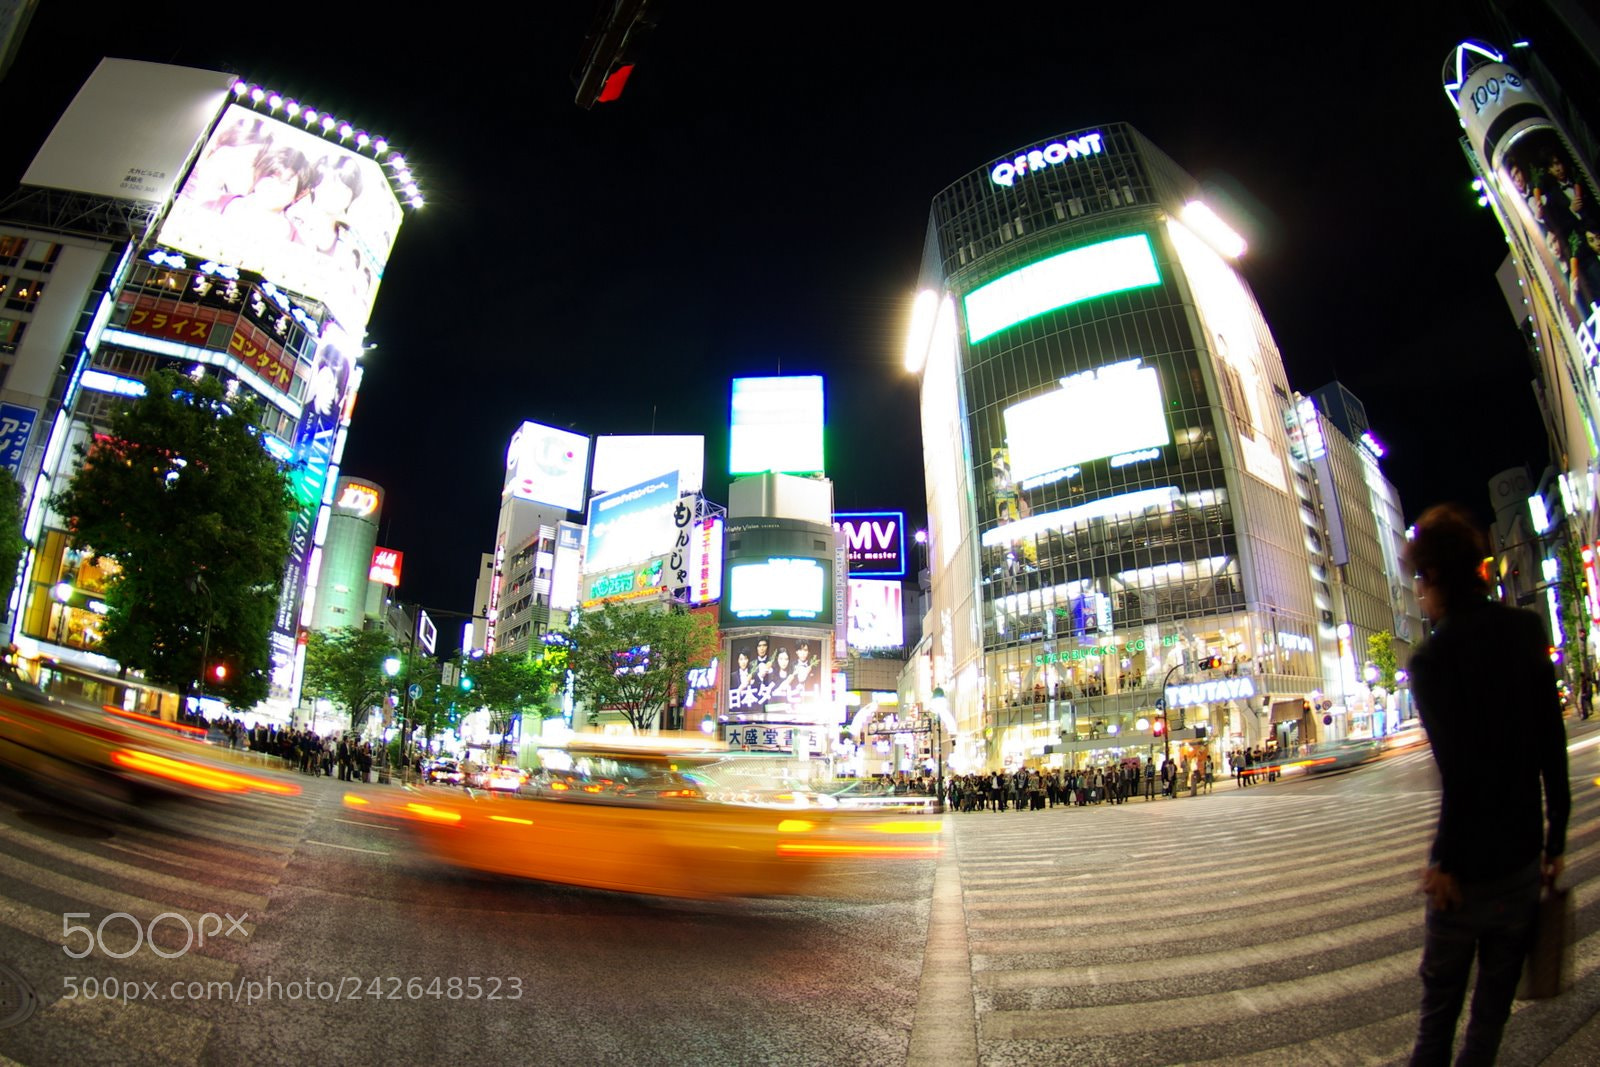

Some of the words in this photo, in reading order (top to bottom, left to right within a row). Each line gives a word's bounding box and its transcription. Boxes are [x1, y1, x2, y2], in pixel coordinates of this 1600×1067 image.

[992, 133, 1101, 187] QFRONT
[231, 331, 291, 385] コンタクト
[670, 501, 692, 583] もんじゃ
[833, 521, 896, 550] MV
[1035, 645, 1117, 667] STARBUCKS
[1165, 677, 1255, 706] TSUTAYA
